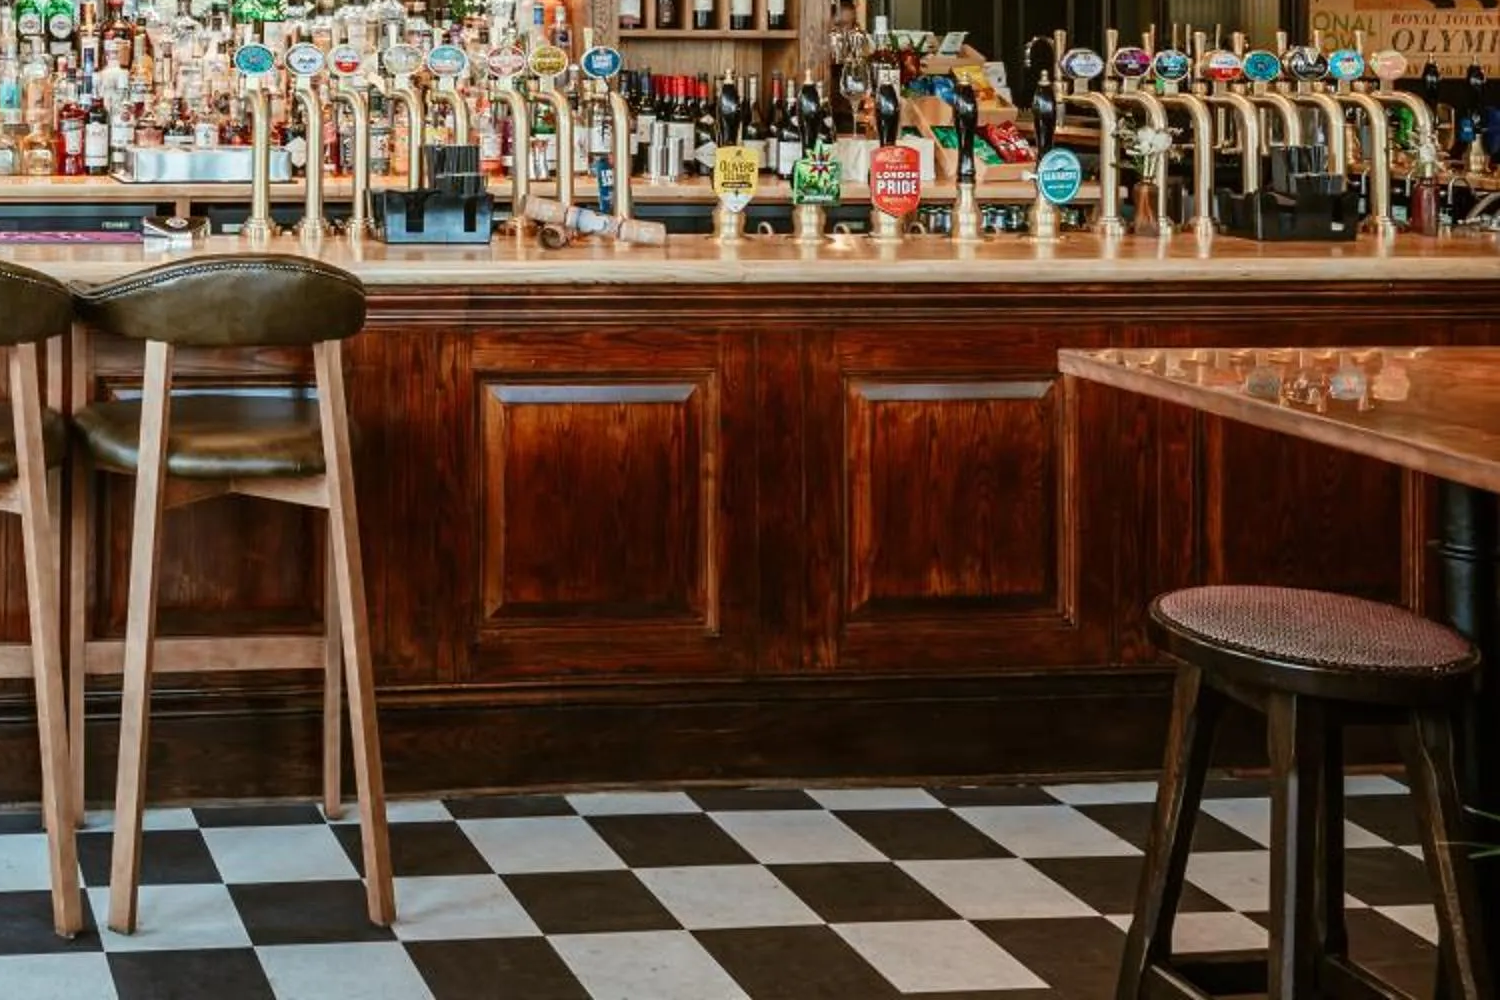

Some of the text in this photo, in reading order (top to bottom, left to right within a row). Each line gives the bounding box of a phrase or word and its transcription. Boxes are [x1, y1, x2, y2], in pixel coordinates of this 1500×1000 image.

[1391, 13, 1437, 25] ROYAL
[875, 171, 919, 179] LONDON
[876, 180, 917, 194] PRIDE
